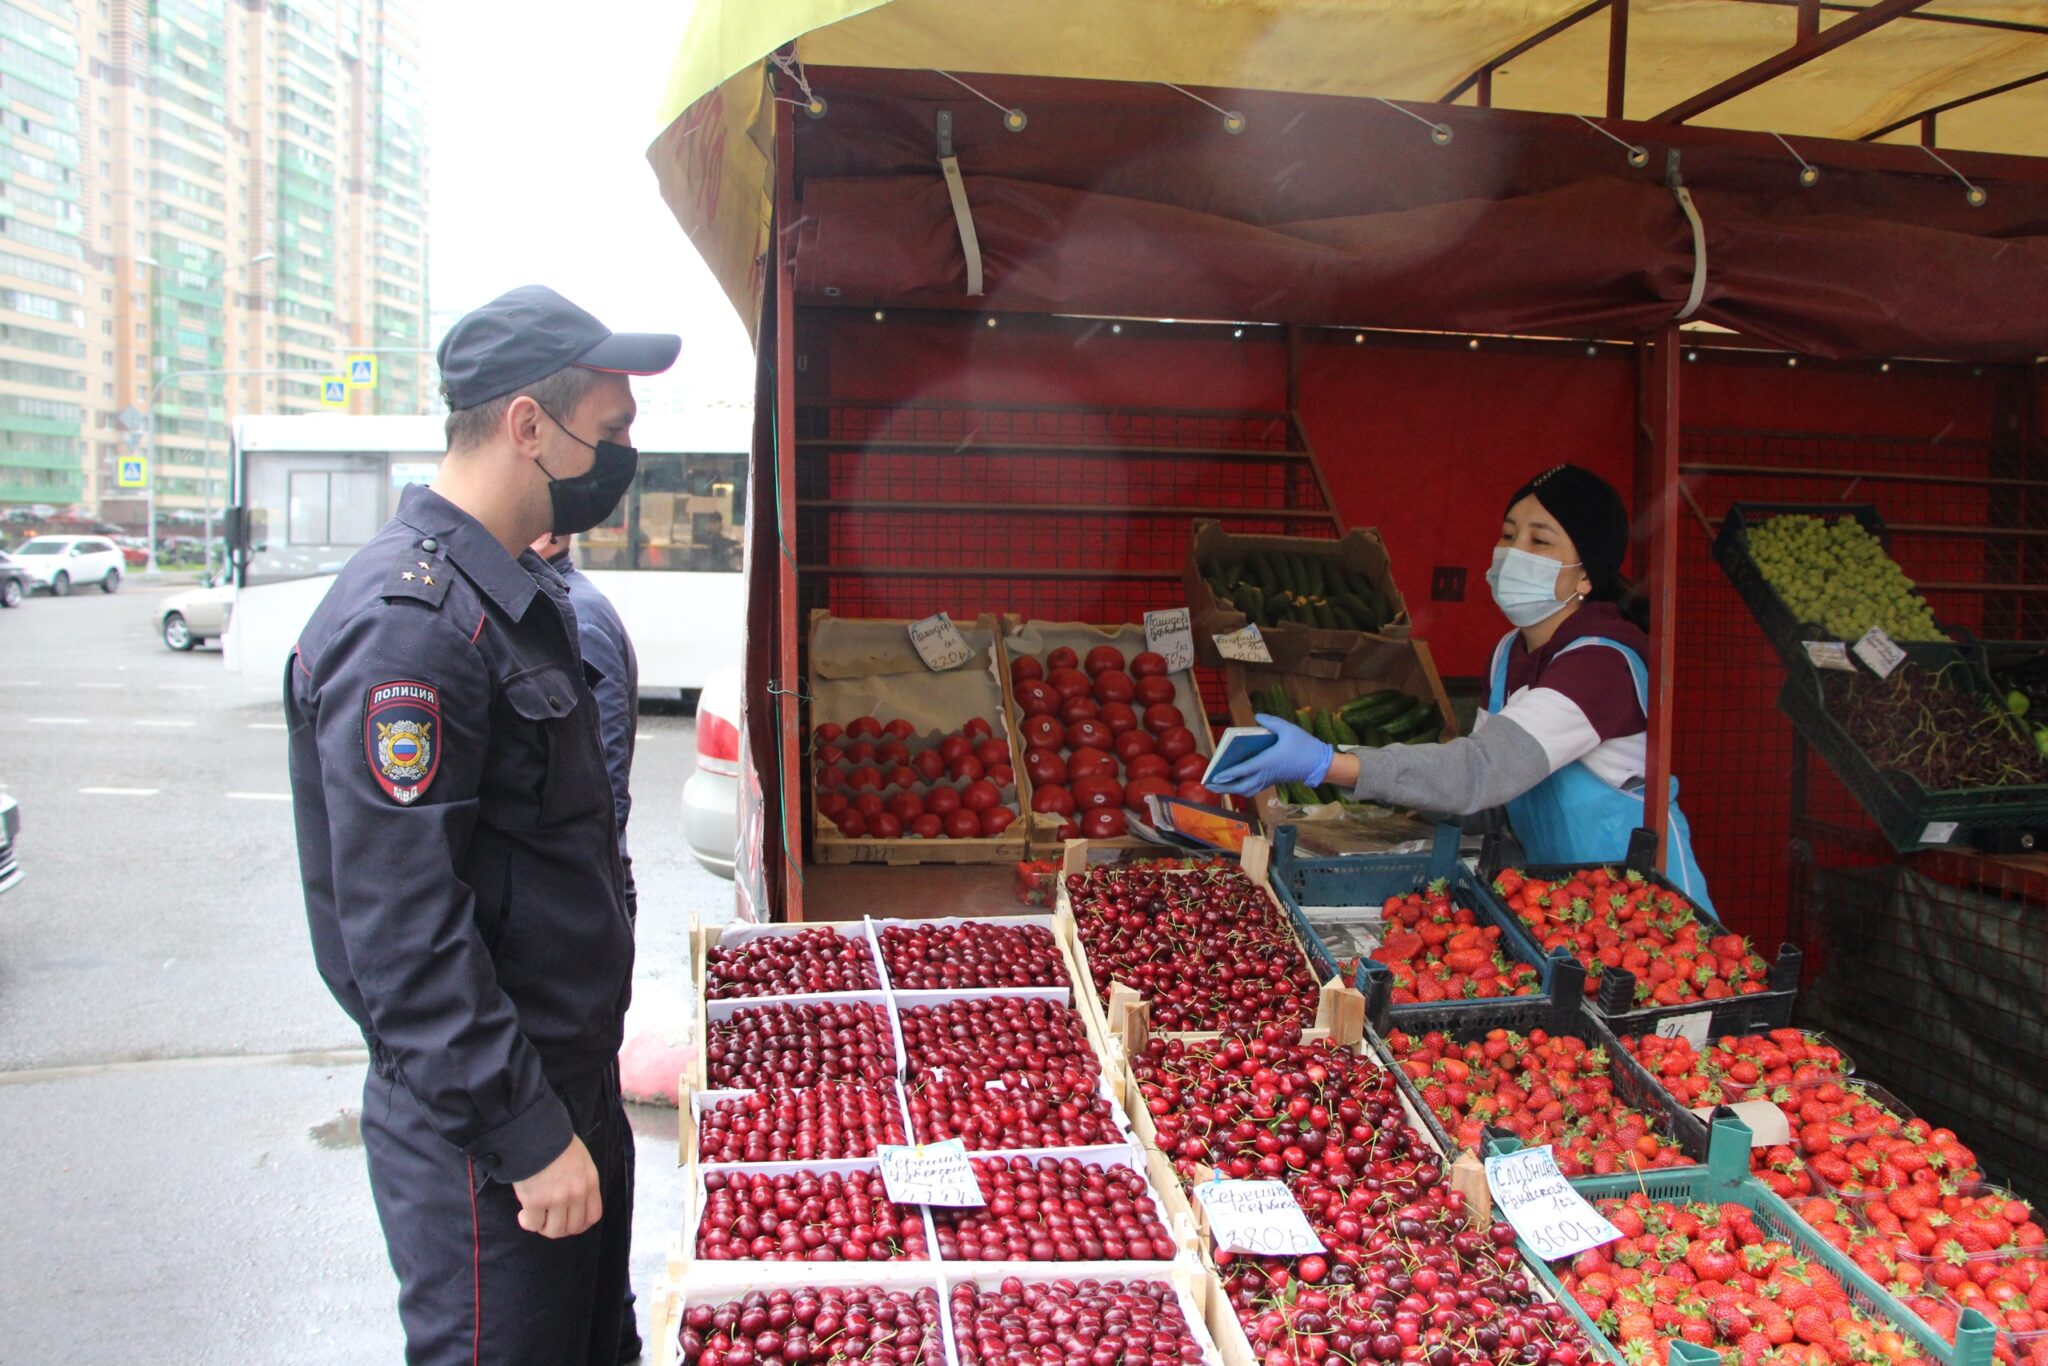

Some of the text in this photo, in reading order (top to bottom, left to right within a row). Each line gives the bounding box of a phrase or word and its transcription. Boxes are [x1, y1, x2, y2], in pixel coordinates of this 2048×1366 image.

[374, 686, 435, 704] ПОЛИЦИЯ
[393, 785, 419, 802] МВД
[1201, 1187, 1290, 1211] Черешня
[1533, 1220, 1601, 1250] 360р
